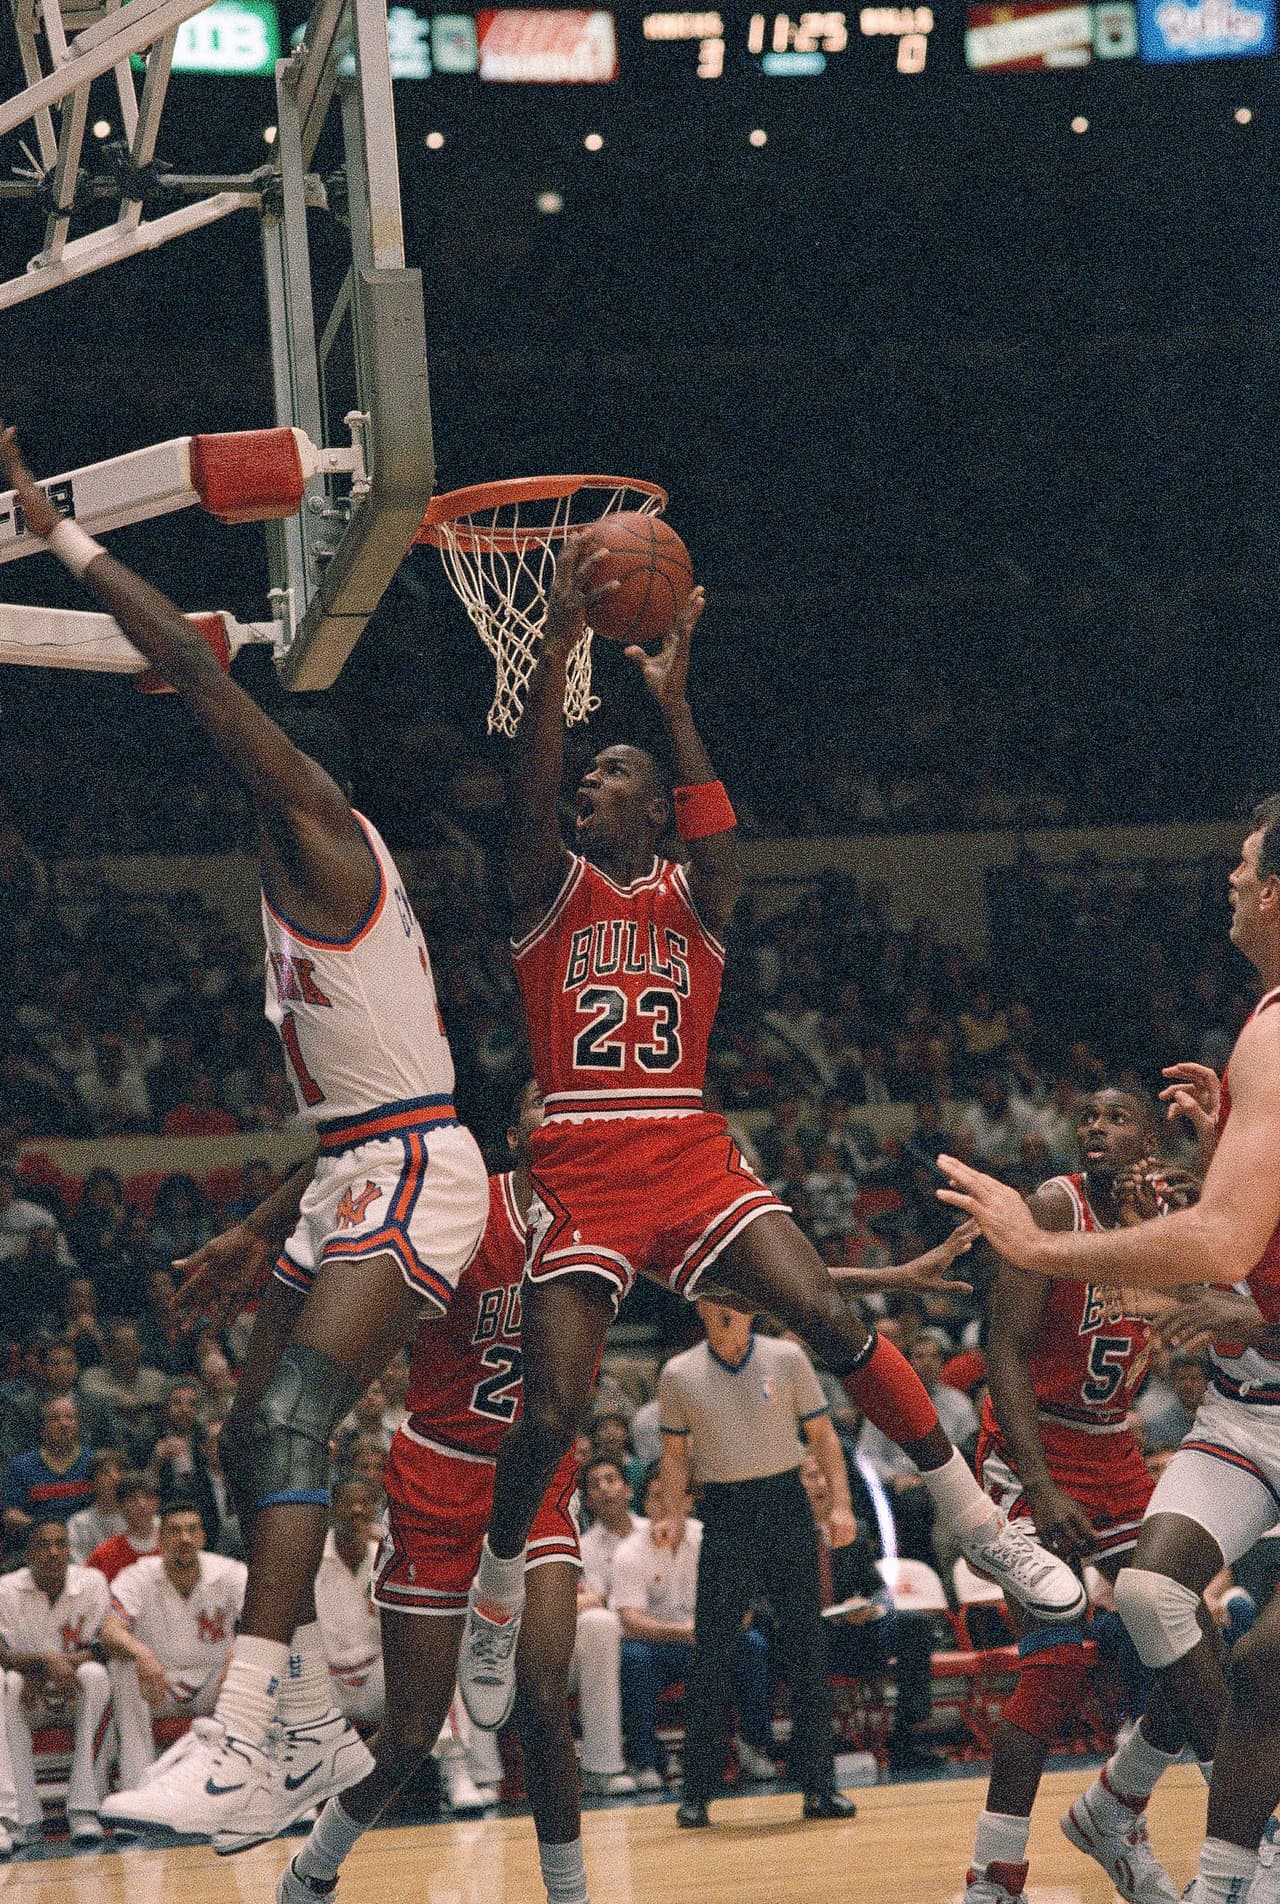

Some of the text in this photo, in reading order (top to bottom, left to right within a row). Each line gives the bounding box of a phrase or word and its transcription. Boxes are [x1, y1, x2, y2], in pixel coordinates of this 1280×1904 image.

[562, 919, 691, 998] BULLS
[572, 984, 683, 1073] 23
[1080, 1335, 1132, 1405] 5
